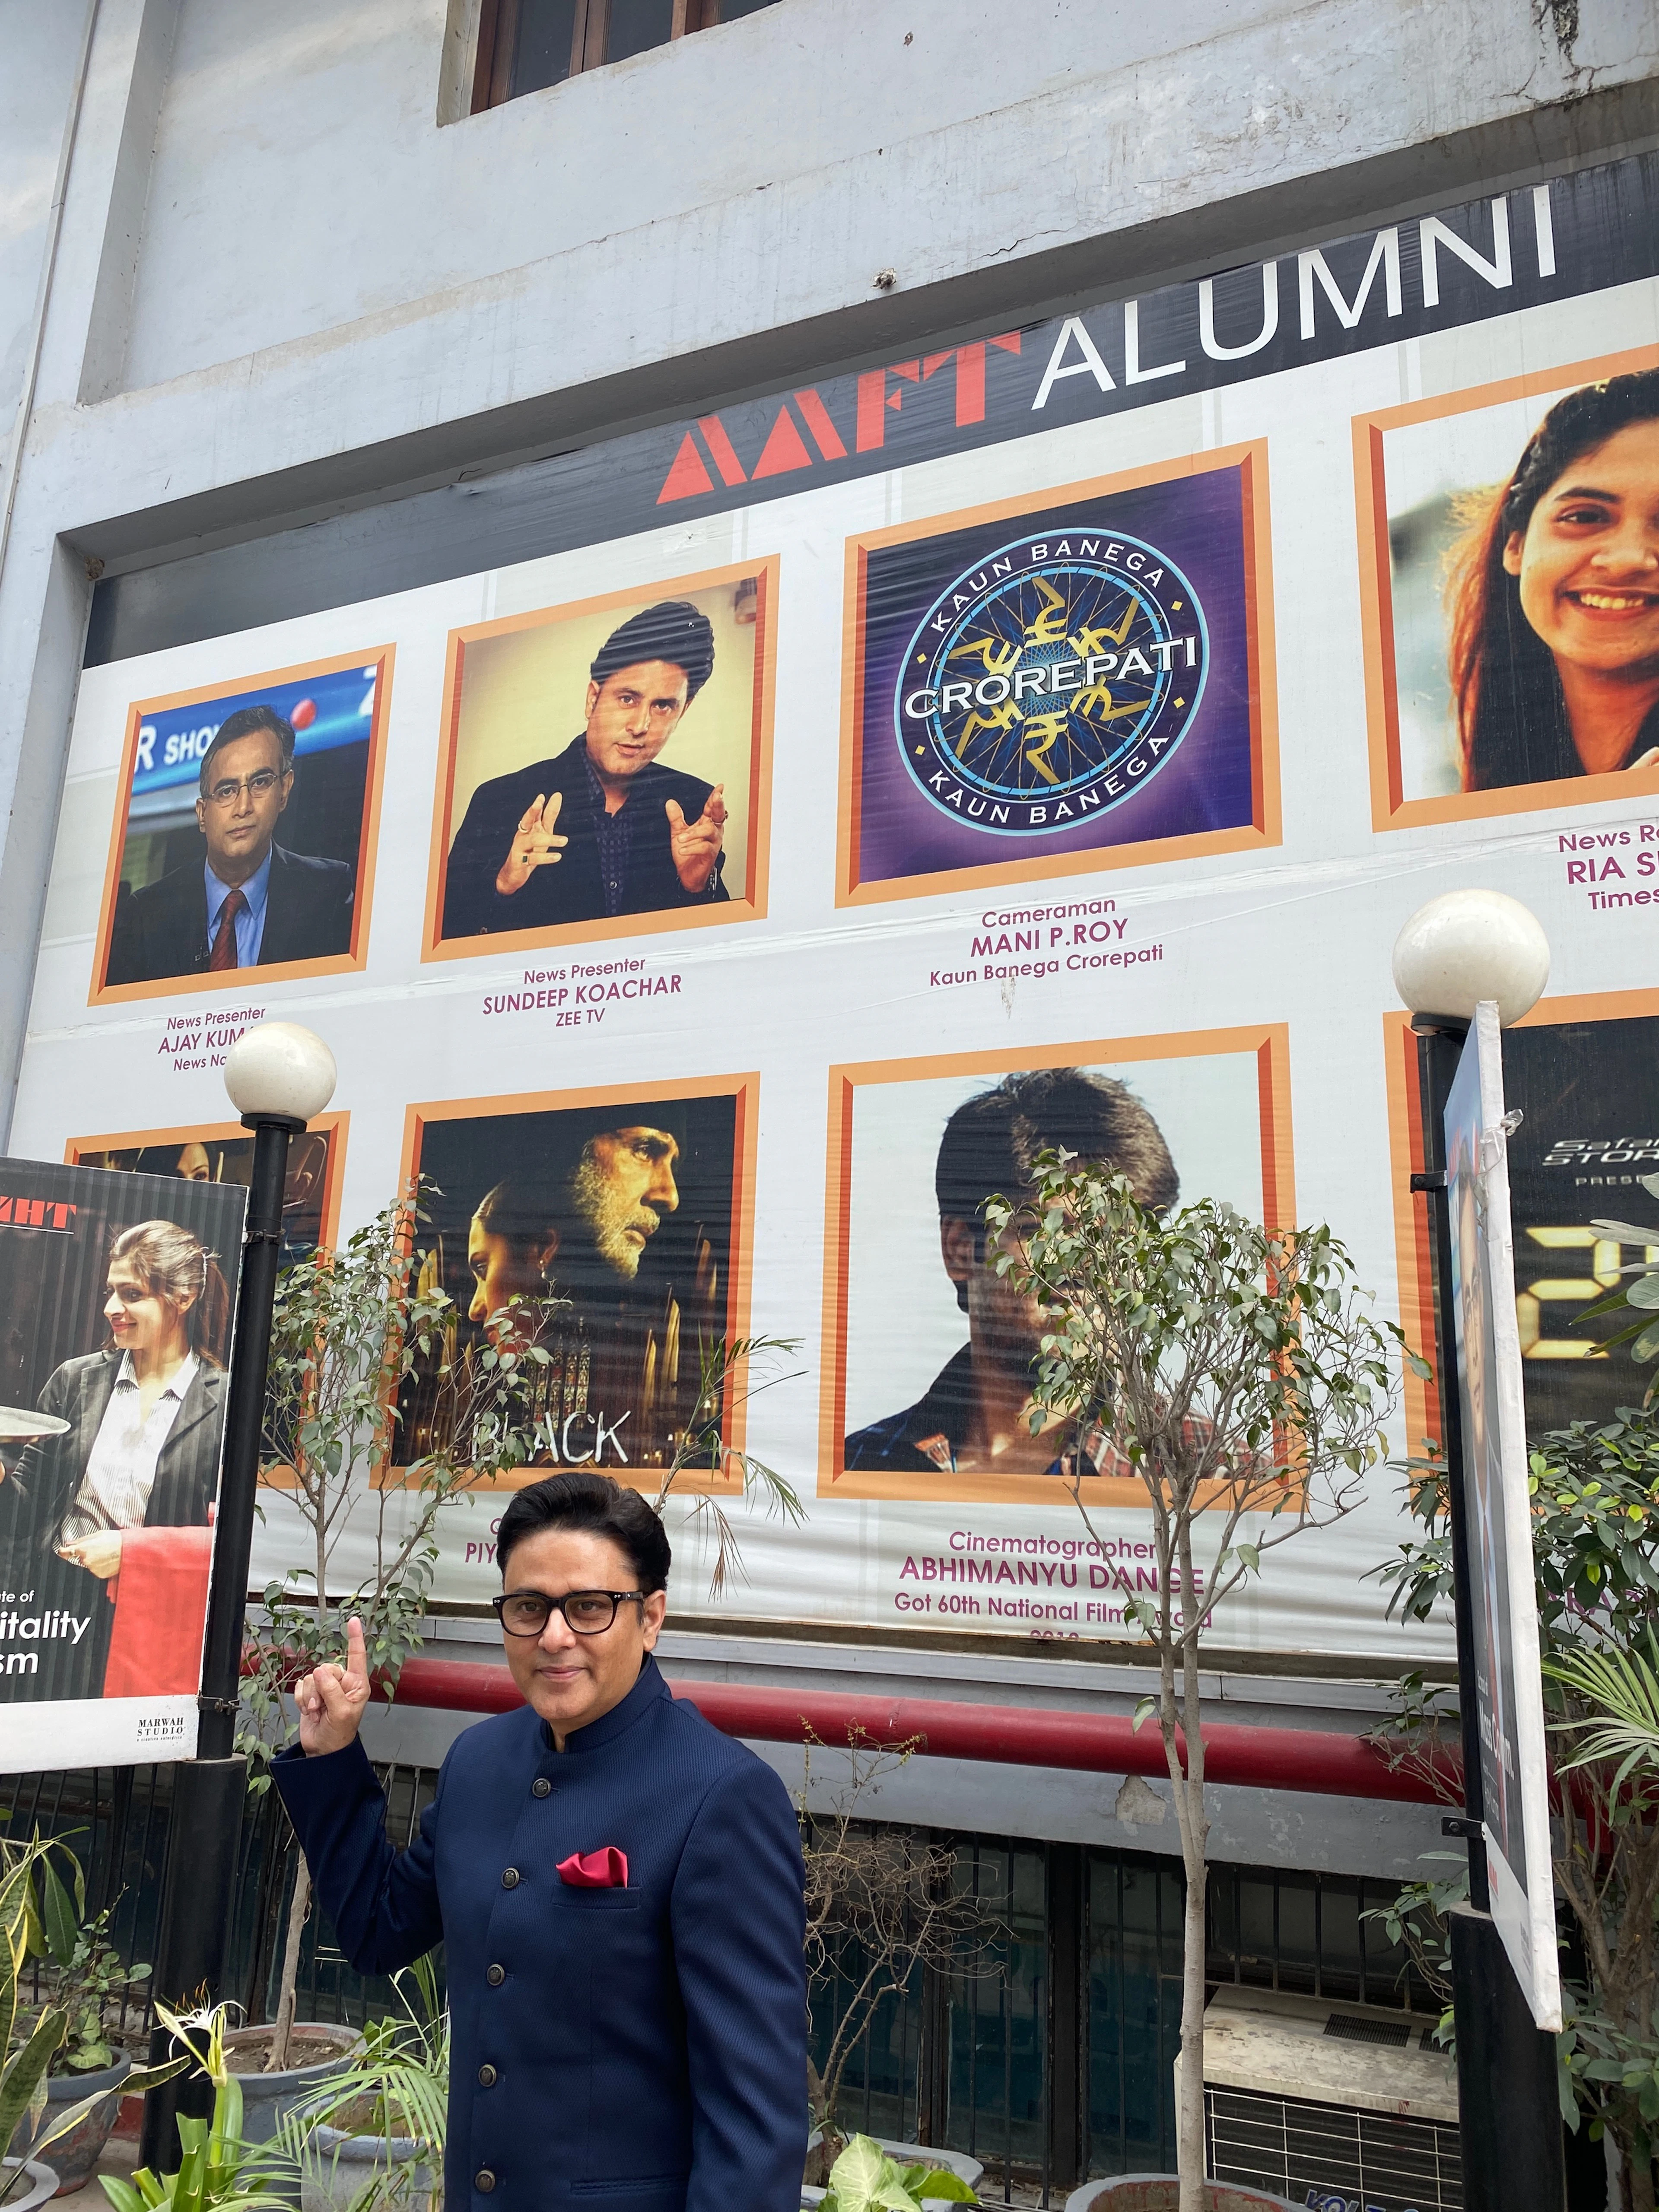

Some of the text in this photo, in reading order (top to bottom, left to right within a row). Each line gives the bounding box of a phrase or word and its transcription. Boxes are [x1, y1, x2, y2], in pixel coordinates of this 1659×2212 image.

[1031, 184, 1556, 410] ALUMNI
[930, 539, 1165, 633] KAUN BANEGA
[904, 636, 1198, 720] CROREPATI
[163, 723, 221, 766] SHO
[928, 736, 1170, 824] KAUN BANEGA
[1558, 824, 1659, 852] News R
[1567, 850, 1659, 884] RIA S
[982, 899, 1116, 928] Cameraman
[970, 918, 1128, 957] MANI P.ROY
[524, 958, 646, 984] News Presenter
[930, 944, 1163, 986] Kaun Banega Crorepati
[482, 974, 682, 1015] SUNDEEP KOACHAR
[167, 1007, 266, 1030] News Presenter
[556, 1008, 606, 1027] ZEE TV
[157, 1026, 254, 1054] AJAY KUM
[173, 1058, 207, 1071] News
[949, 1531, 1157, 1562] Cinematographer
[899, 1556, 1077, 1588] ABHIMANYU
[0, 1589, 35, 1603] te of
[894, 1592, 931, 1611] Got
[938, 1595, 980, 1615] 60th
[988, 1597, 1078, 1621] National
[1086, 1602, 1125, 1623] Film
[137, 1726, 183, 1736] STUDIO
[138, 1717, 184, 1728] MARWAH
